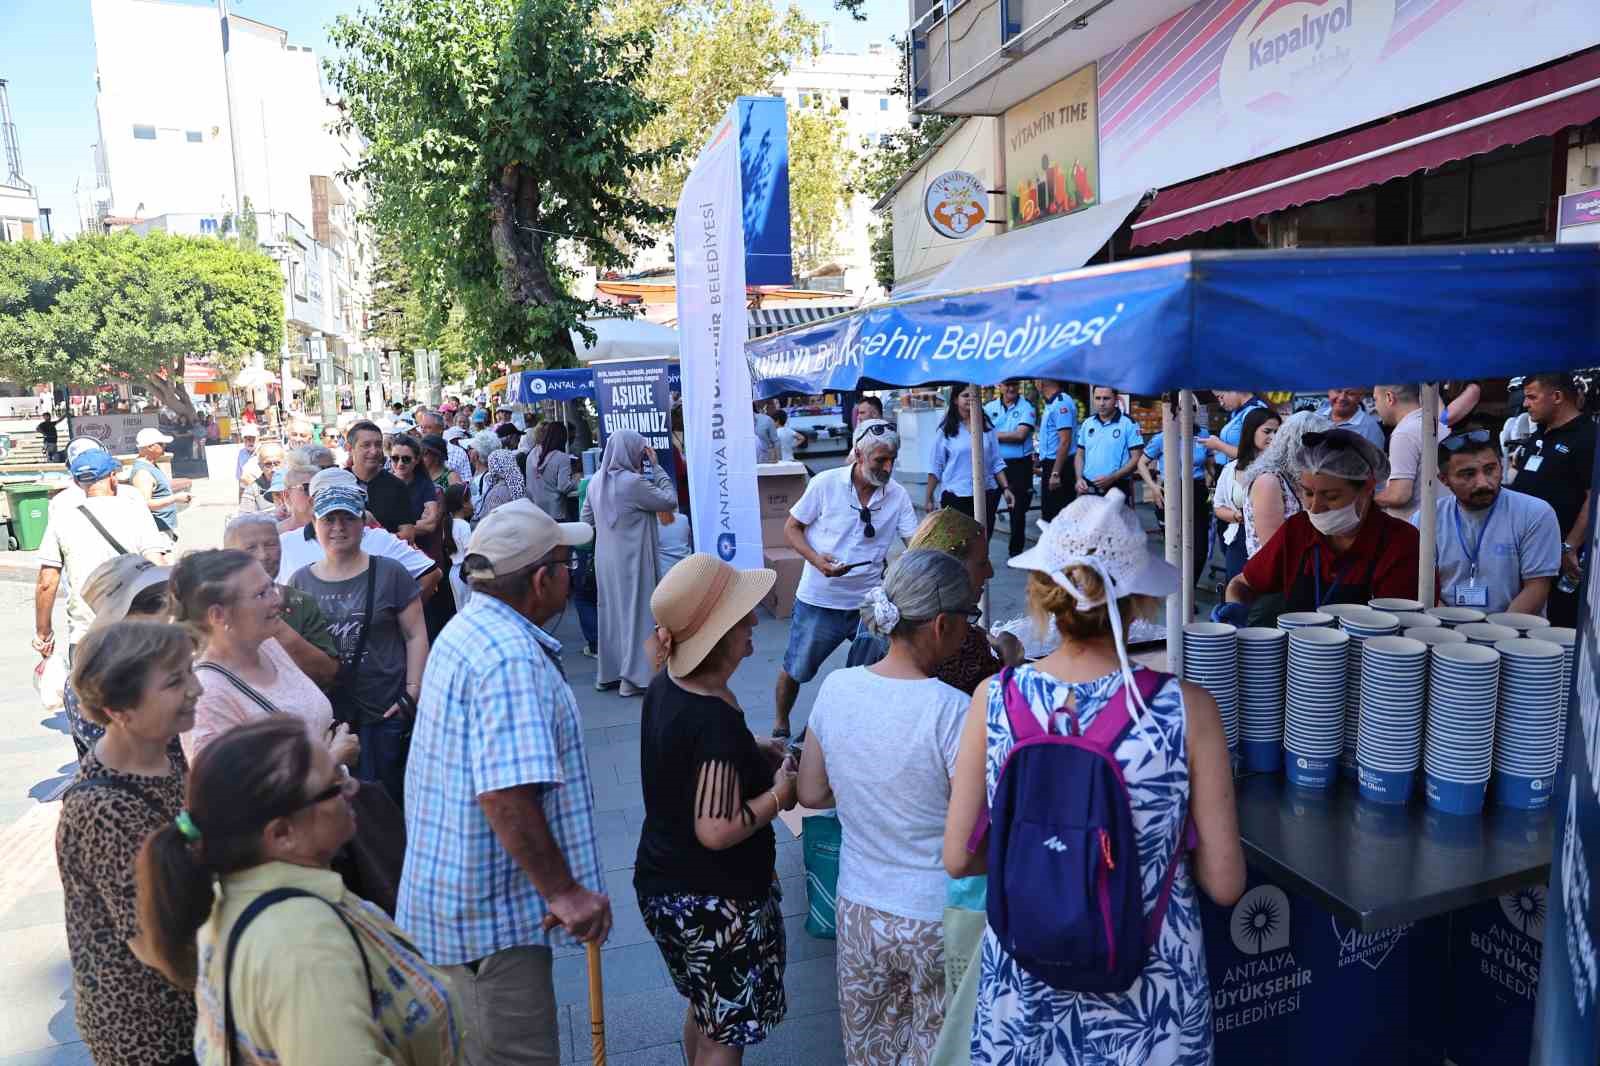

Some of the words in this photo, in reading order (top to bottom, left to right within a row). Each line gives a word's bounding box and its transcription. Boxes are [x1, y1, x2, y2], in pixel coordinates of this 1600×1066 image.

[1059, 102, 1088, 125] TIME
[700, 202, 721, 305] BELEDİYESİ
[931, 302, 1125, 363] Belediyesi
[612, 384, 654, 409] AŞURE
[712, 446, 731, 530] ANTALYA
[1489, 923, 1543, 961] ANTAL
[1214, 967, 1313, 1010] ÜYÜKŞEHİR
[1222, 952, 1296, 985] ANTALYA
[1215, 991, 1301, 1033] BELEDİYESİ
